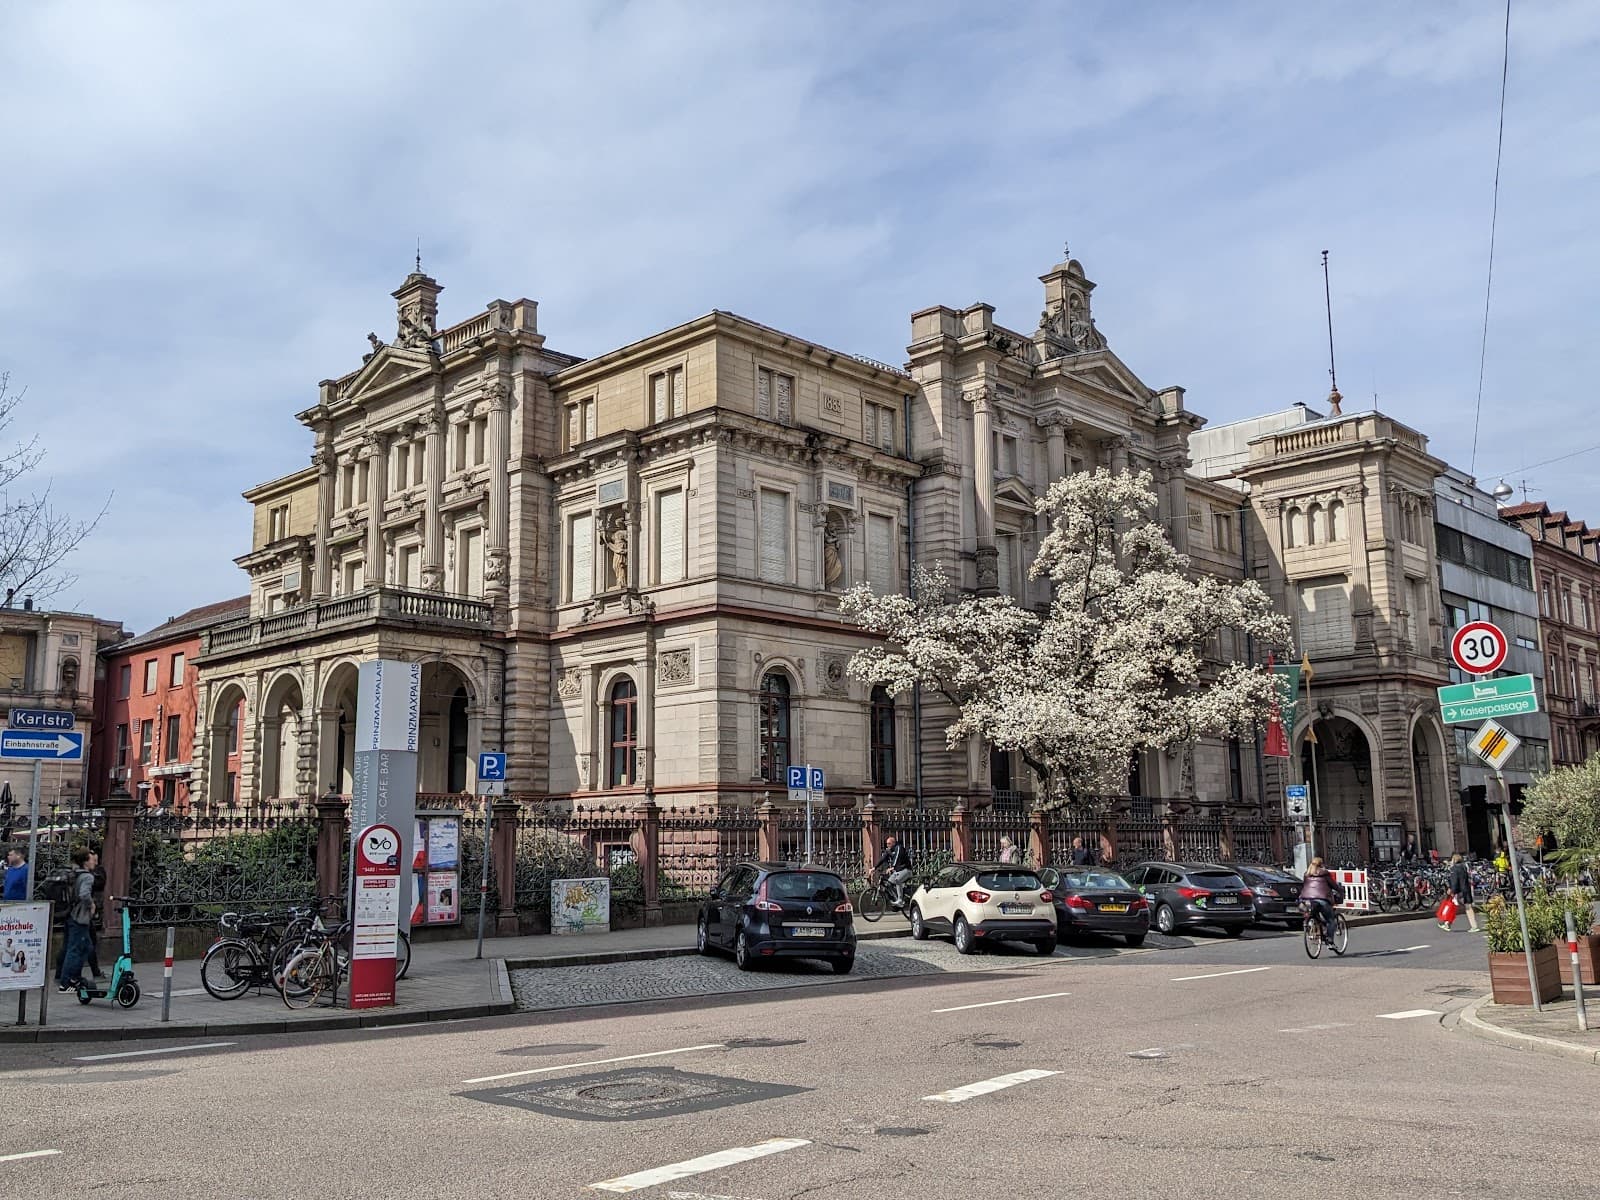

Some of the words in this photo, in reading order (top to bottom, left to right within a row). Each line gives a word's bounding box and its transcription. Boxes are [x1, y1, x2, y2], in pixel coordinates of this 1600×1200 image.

[1463, 635, 1495, 660] 30
[373, 661, 383, 750] PRINZMAXPALAIS
[407, 664, 419, 751] PRINZMAXPALAIS
[1460, 701, 1529, 717] Kaiserpassage
[16, 712, 70, 726] Karlstr.
[5, 740, 59, 750] Einbahnstraße
[381, 753, 389, 774] BAR
[482, 756, 498, 777] P
[790, 769, 802, 786] P
[813, 770, 822, 787] P
[361, 755, 369, 827] TERATURHAUS
[0, 922, 34, 931] ochschule
